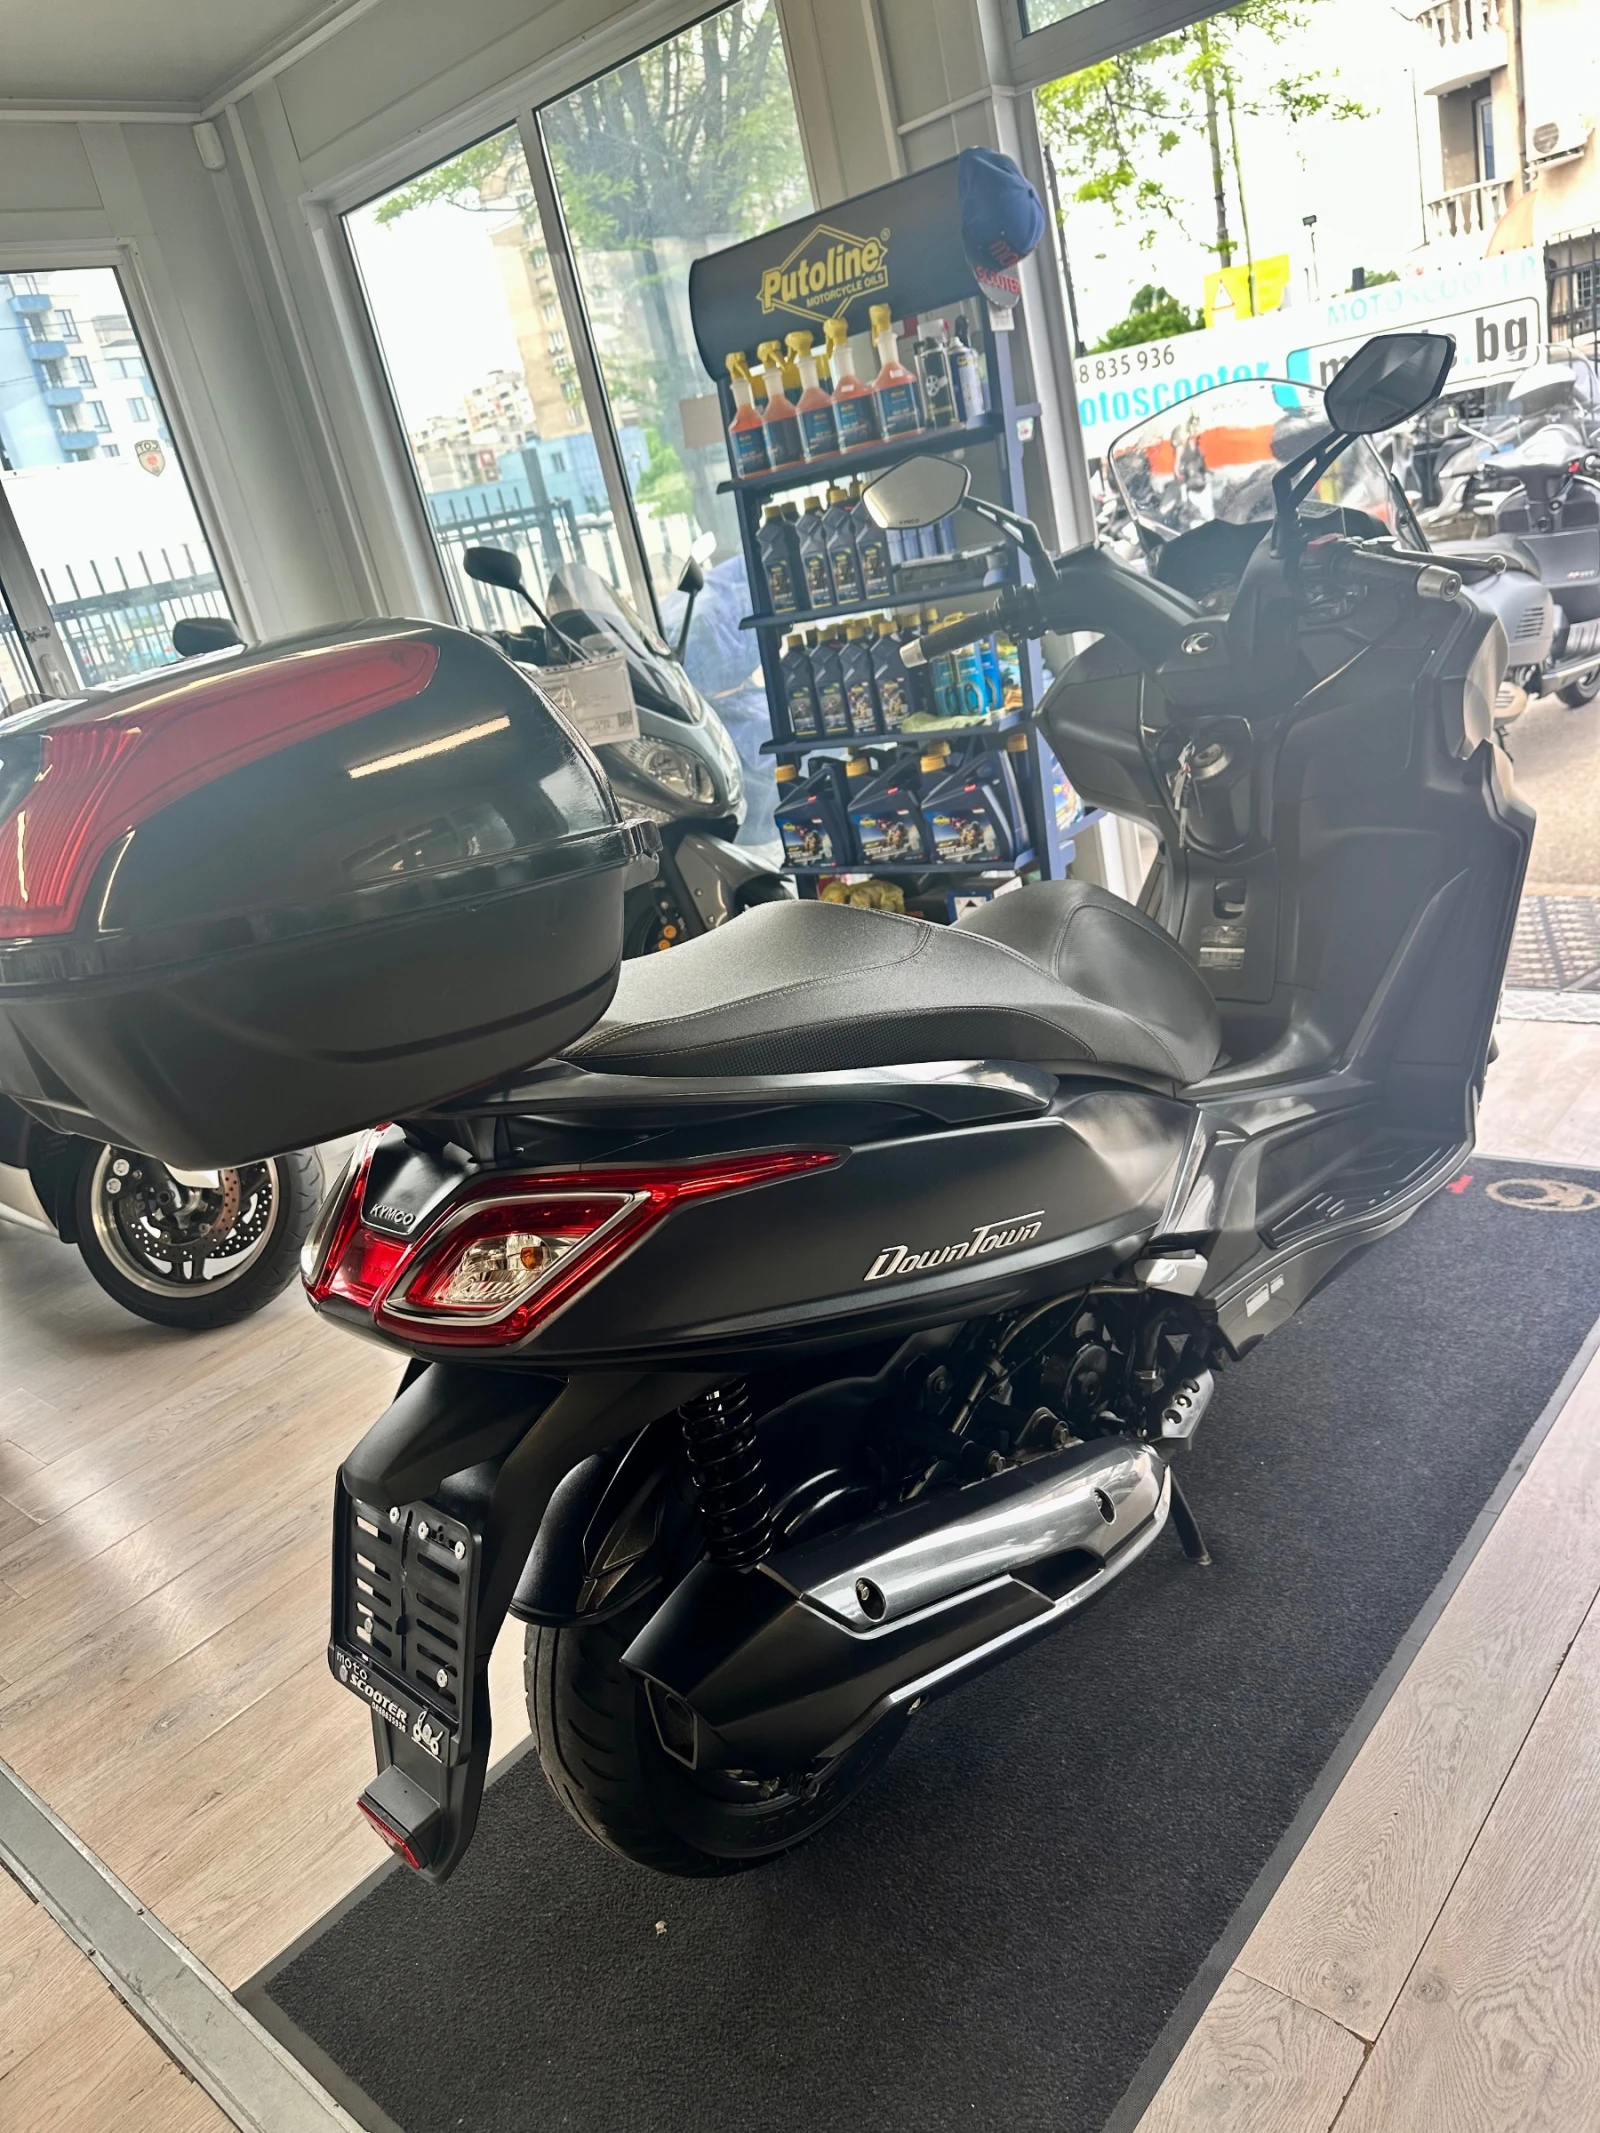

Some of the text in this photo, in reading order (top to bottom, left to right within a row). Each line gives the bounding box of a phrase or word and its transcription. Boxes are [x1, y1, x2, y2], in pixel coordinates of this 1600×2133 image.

[763, 240, 880, 310] Putoline
[806, 272, 885, 308] MOTORCYCLE OILS
[1326, 254, 1537, 328] MOTOSCOOER
[1095, 354, 1132, 382] 835
[1137, 344, 1176, 373] 936
[1078, 360, 1270, 428] otoscooter
[370, 1203, 414, 1225] KYMCO
[863, 1210, 1046, 1282] DownTown
[336, 1650, 368, 1681] moto
[349, 1673, 409, 1725] SCOOTER
